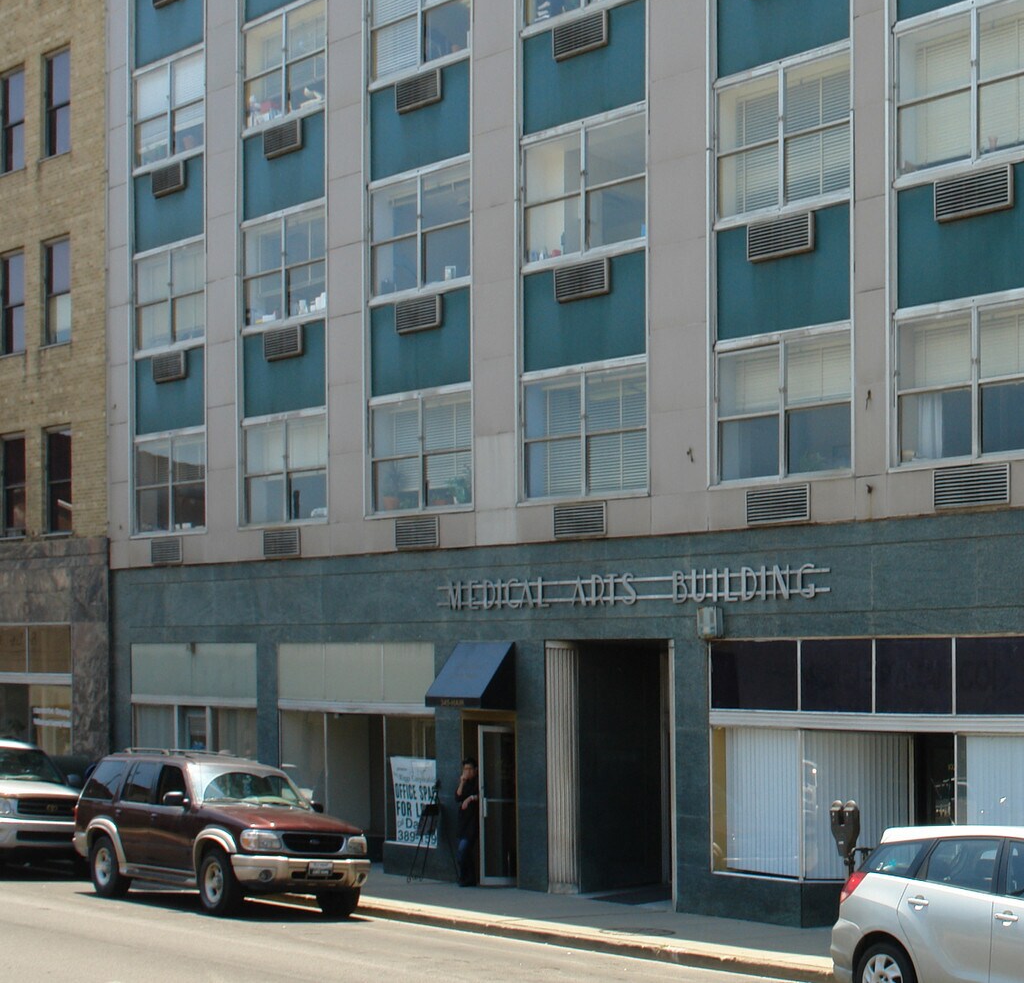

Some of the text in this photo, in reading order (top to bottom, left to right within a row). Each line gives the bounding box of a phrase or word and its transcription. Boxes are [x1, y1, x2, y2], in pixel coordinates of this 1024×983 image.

[449, 563, 815, 610] MEDICAL ARTS BUILDING
[395, 783, 416, 800] OFFICE
[396, 801, 412, 817] FOR
